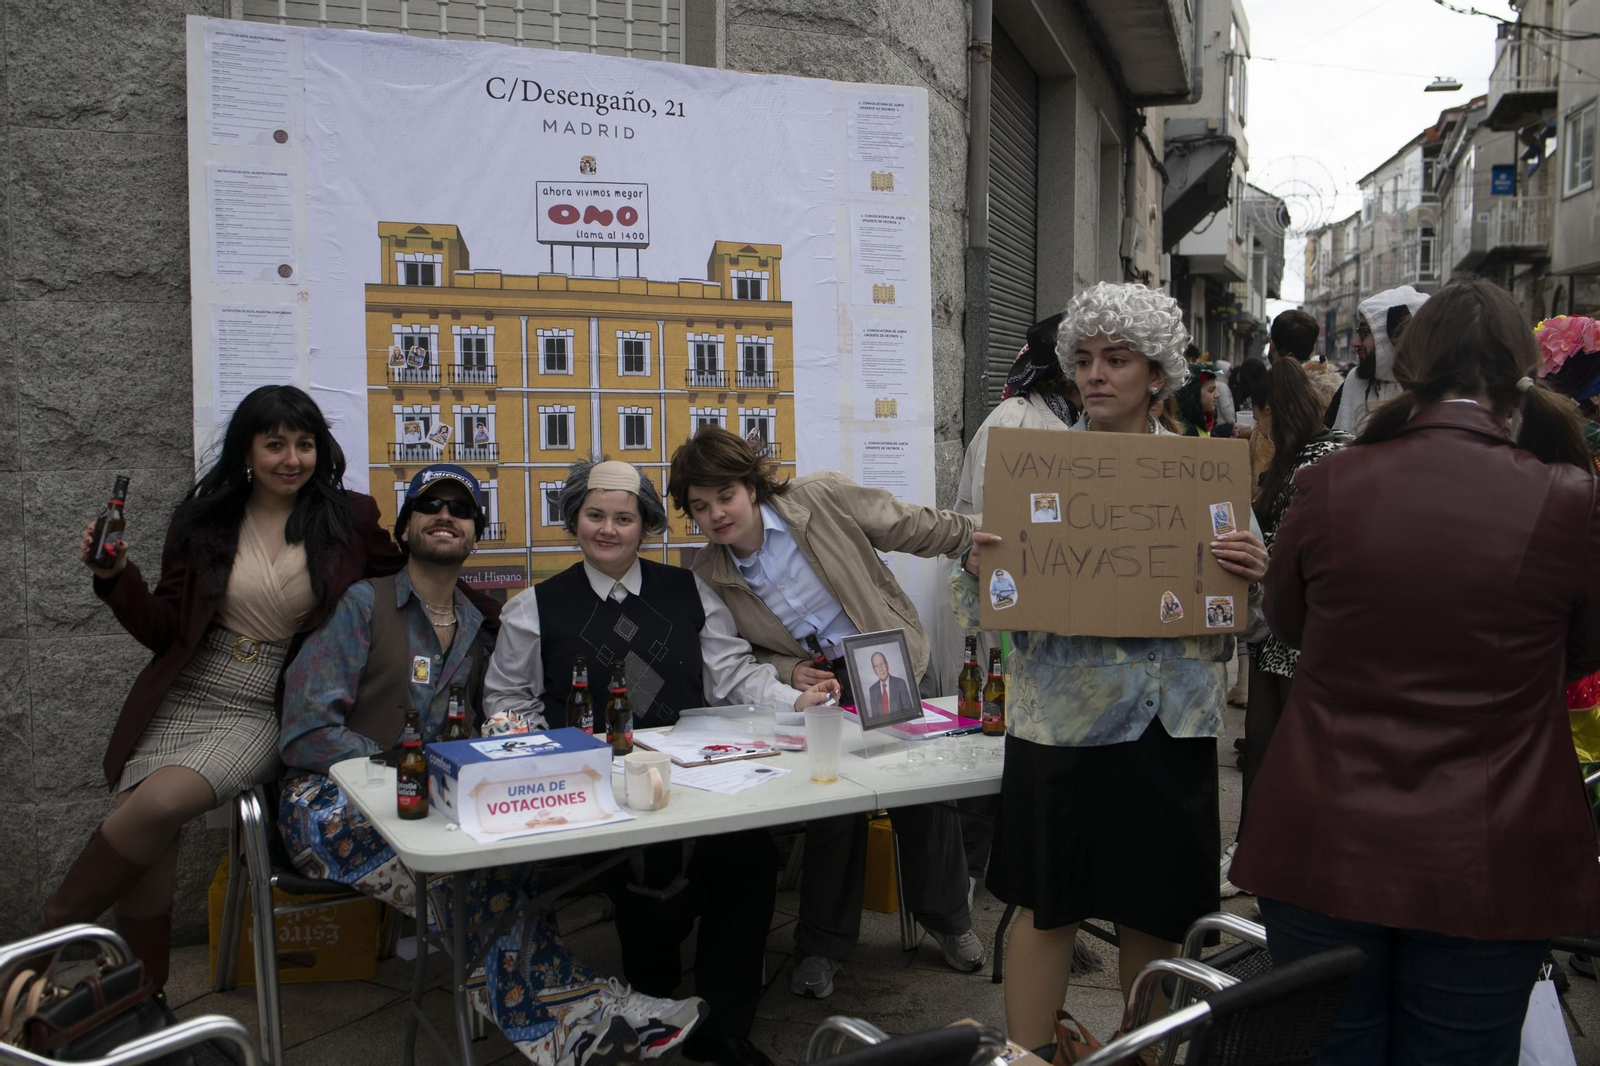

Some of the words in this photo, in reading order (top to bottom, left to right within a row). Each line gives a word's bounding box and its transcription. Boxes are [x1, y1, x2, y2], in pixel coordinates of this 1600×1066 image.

[485, 76, 657, 118] C/Desengaño,
[664, 99, 686, 118] 21
[543, 119, 635, 140] MADRID
[542, 187, 572, 197] ahora
[576, 189, 611, 198] vivimos
[614, 189, 643, 200] megor
[548, 204, 638, 227] ONO
[576, 230, 604, 240] llama
[608, 231, 616, 240] al
[621, 231, 645, 241] 1400
[1000, 452, 1117, 480] VAYASE
[1136, 455, 1233, 483] SEÑOR
[1066, 492, 1187, 531] CUESTA
[459, 572, 482, 584] tral
[484, 572, 522, 584] Hispano
[507, 782, 546, 797] URNA
[549, 780, 566, 792] DE
[486, 791, 587, 816] VOTACIONES
